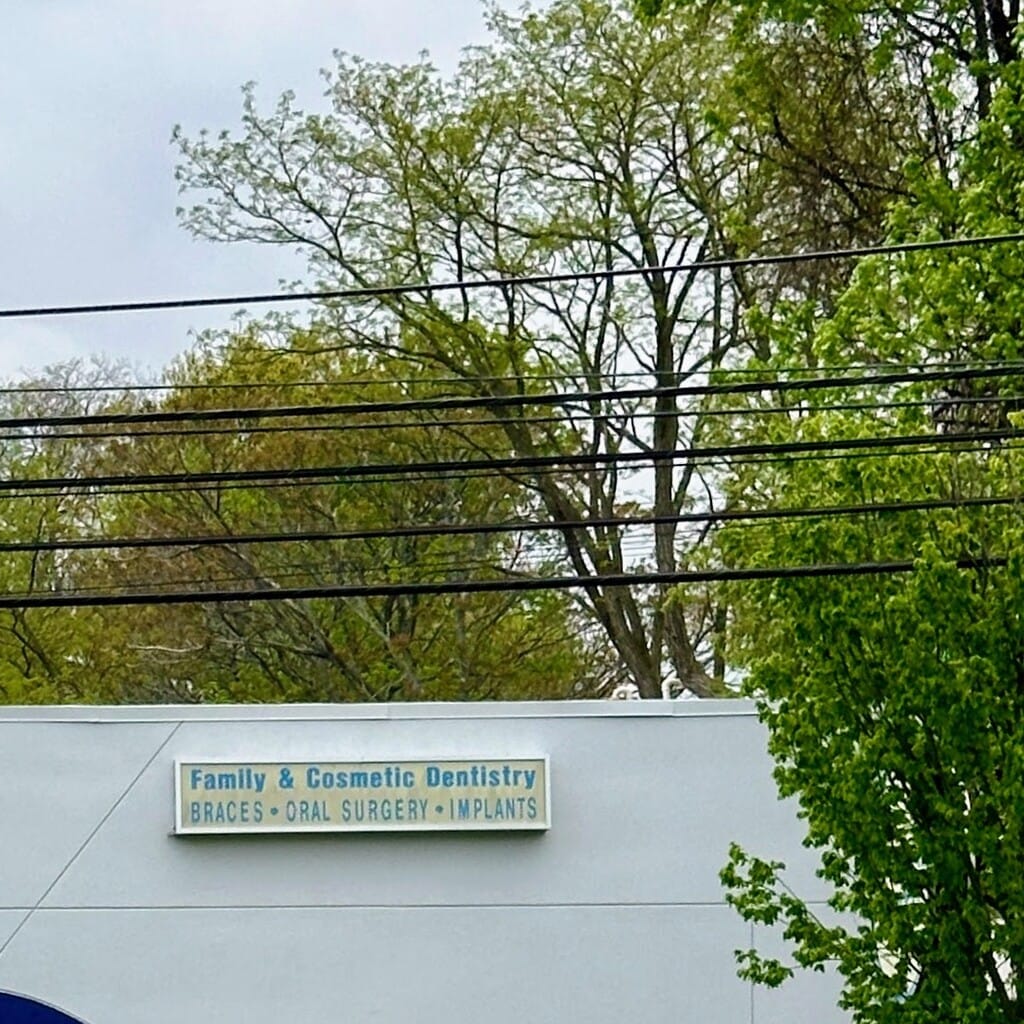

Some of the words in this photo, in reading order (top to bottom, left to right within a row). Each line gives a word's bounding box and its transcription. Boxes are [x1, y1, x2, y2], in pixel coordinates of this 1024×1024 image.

[191, 768, 266, 793] Family
[279, 767, 295, 789] &
[306, 767, 415, 789] Cosmetic
[427, 765, 536, 789] Dentistry
[191, 800, 263, 823] BRACES
[286, 800, 331, 822] ORAL
[342, 798, 428, 822] SURGERY
[450, 797, 537, 820] IMPLANTS
